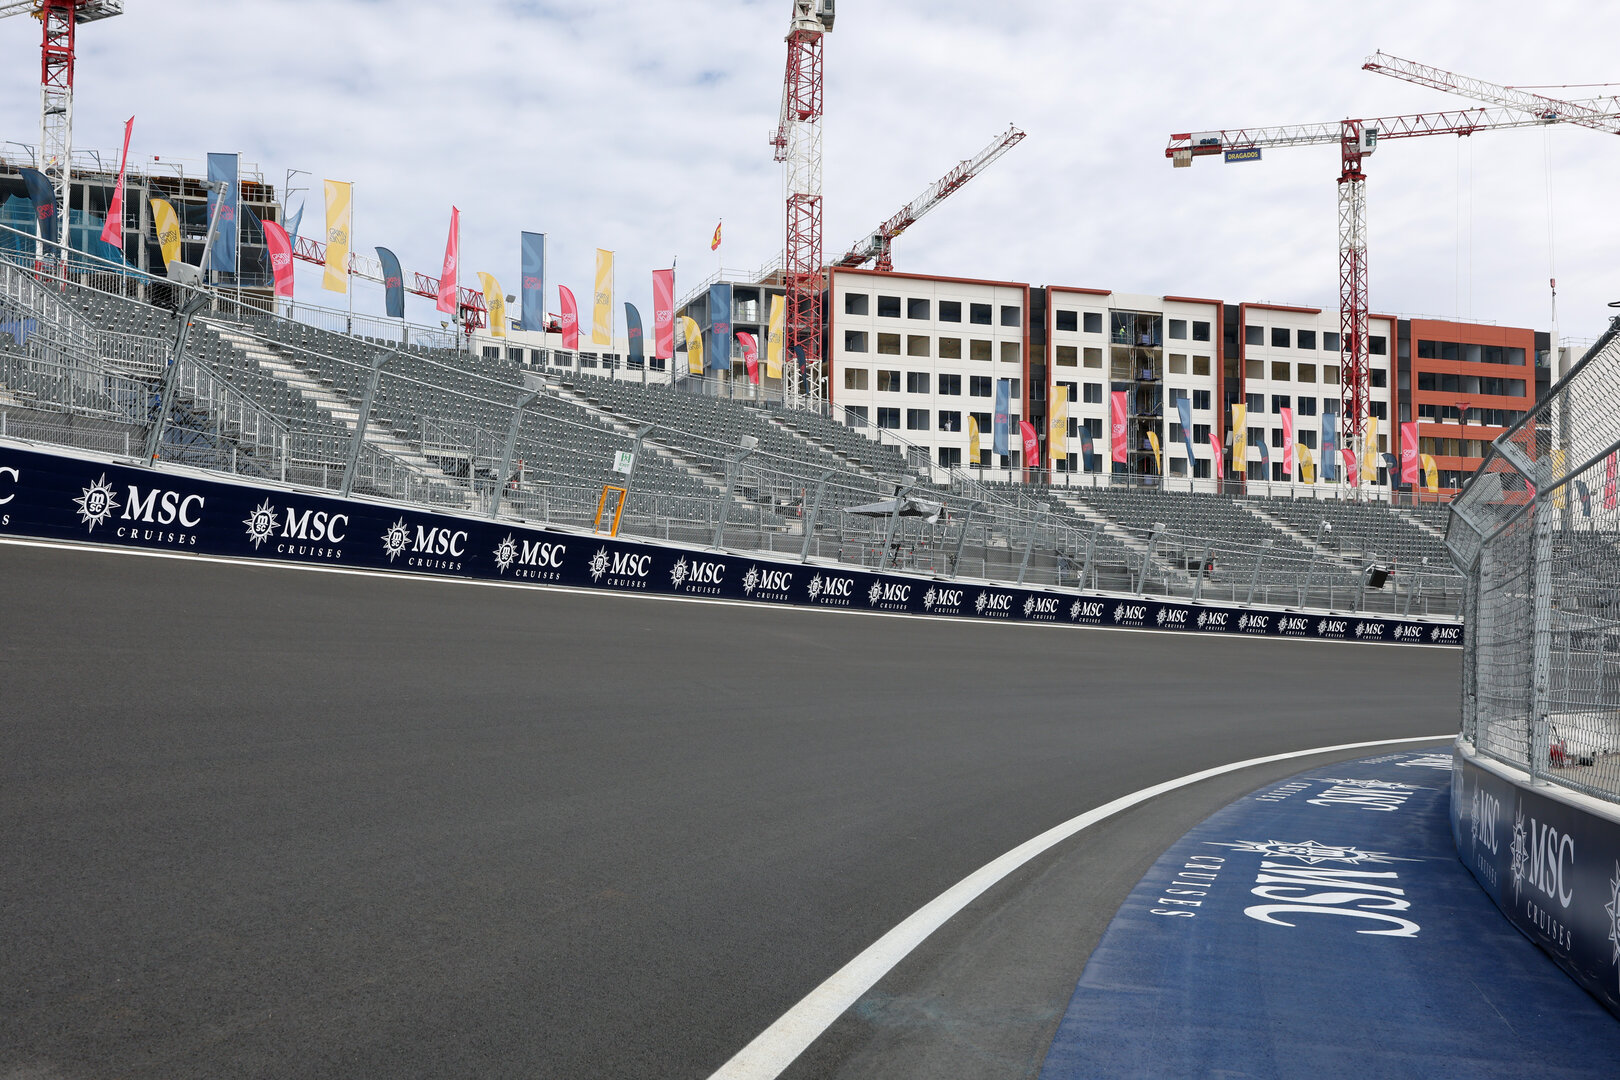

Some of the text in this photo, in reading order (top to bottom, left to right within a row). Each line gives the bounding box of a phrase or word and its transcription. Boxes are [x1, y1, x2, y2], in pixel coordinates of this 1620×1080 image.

[1228, 152, 1258, 160] DRAGADOS
[121, 485, 205, 528] MSC
[281, 507, 349, 543] MSC
[117, 527, 197, 545] CRUISES
[412, 525, 468, 557] MSC
[277, 543, 342, 559] CRUISES
[519, 540, 566, 568] MSC
[409, 557, 462, 570] CRUISES
[610, 551, 652, 577] MSC
[516, 569, 561, 580] CRUISES
[689, 561, 725, 584] MSC
[759, 570, 792, 591] MSC
[607, 578, 647, 588] CRUISES
[686, 585, 721, 594] CRUISES
[823, 577, 854, 597] MSC
[757, 592, 789, 600] CRUISES
[882, 584, 911, 602] MSC
[936, 589, 963, 606] MSC
[987, 594, 1013, 610] MSC
[1035, 598, 1059, 614] MSC
[1081, 602, 1104, 617] MSC
[1124, 606, 1146, 620] MSC
[1167, 609, 1188, 623] MSC
[1207, 612, 1228, 625] MSC
[1249, 615, 1269, 628] MSC
[1288, 618, 1308, 630] MSC
[1327, 621, 1347, 633] MSC
[1365, 623, 1384, 635] MSC
[1404, 626, 1423, 637] MSC
[1440, 628, 1460, 639] MSC
[1306, 786, 1414, 812] MSC
[1479, 790, 1500, 856] MSC
[1528, 818, 1574, 908] MSC
[1150, 856, 1226, 918] CRUISES
[1244, 860, 1421, 938] MSC
[1527, 900, 1572, 952] CRUISES
